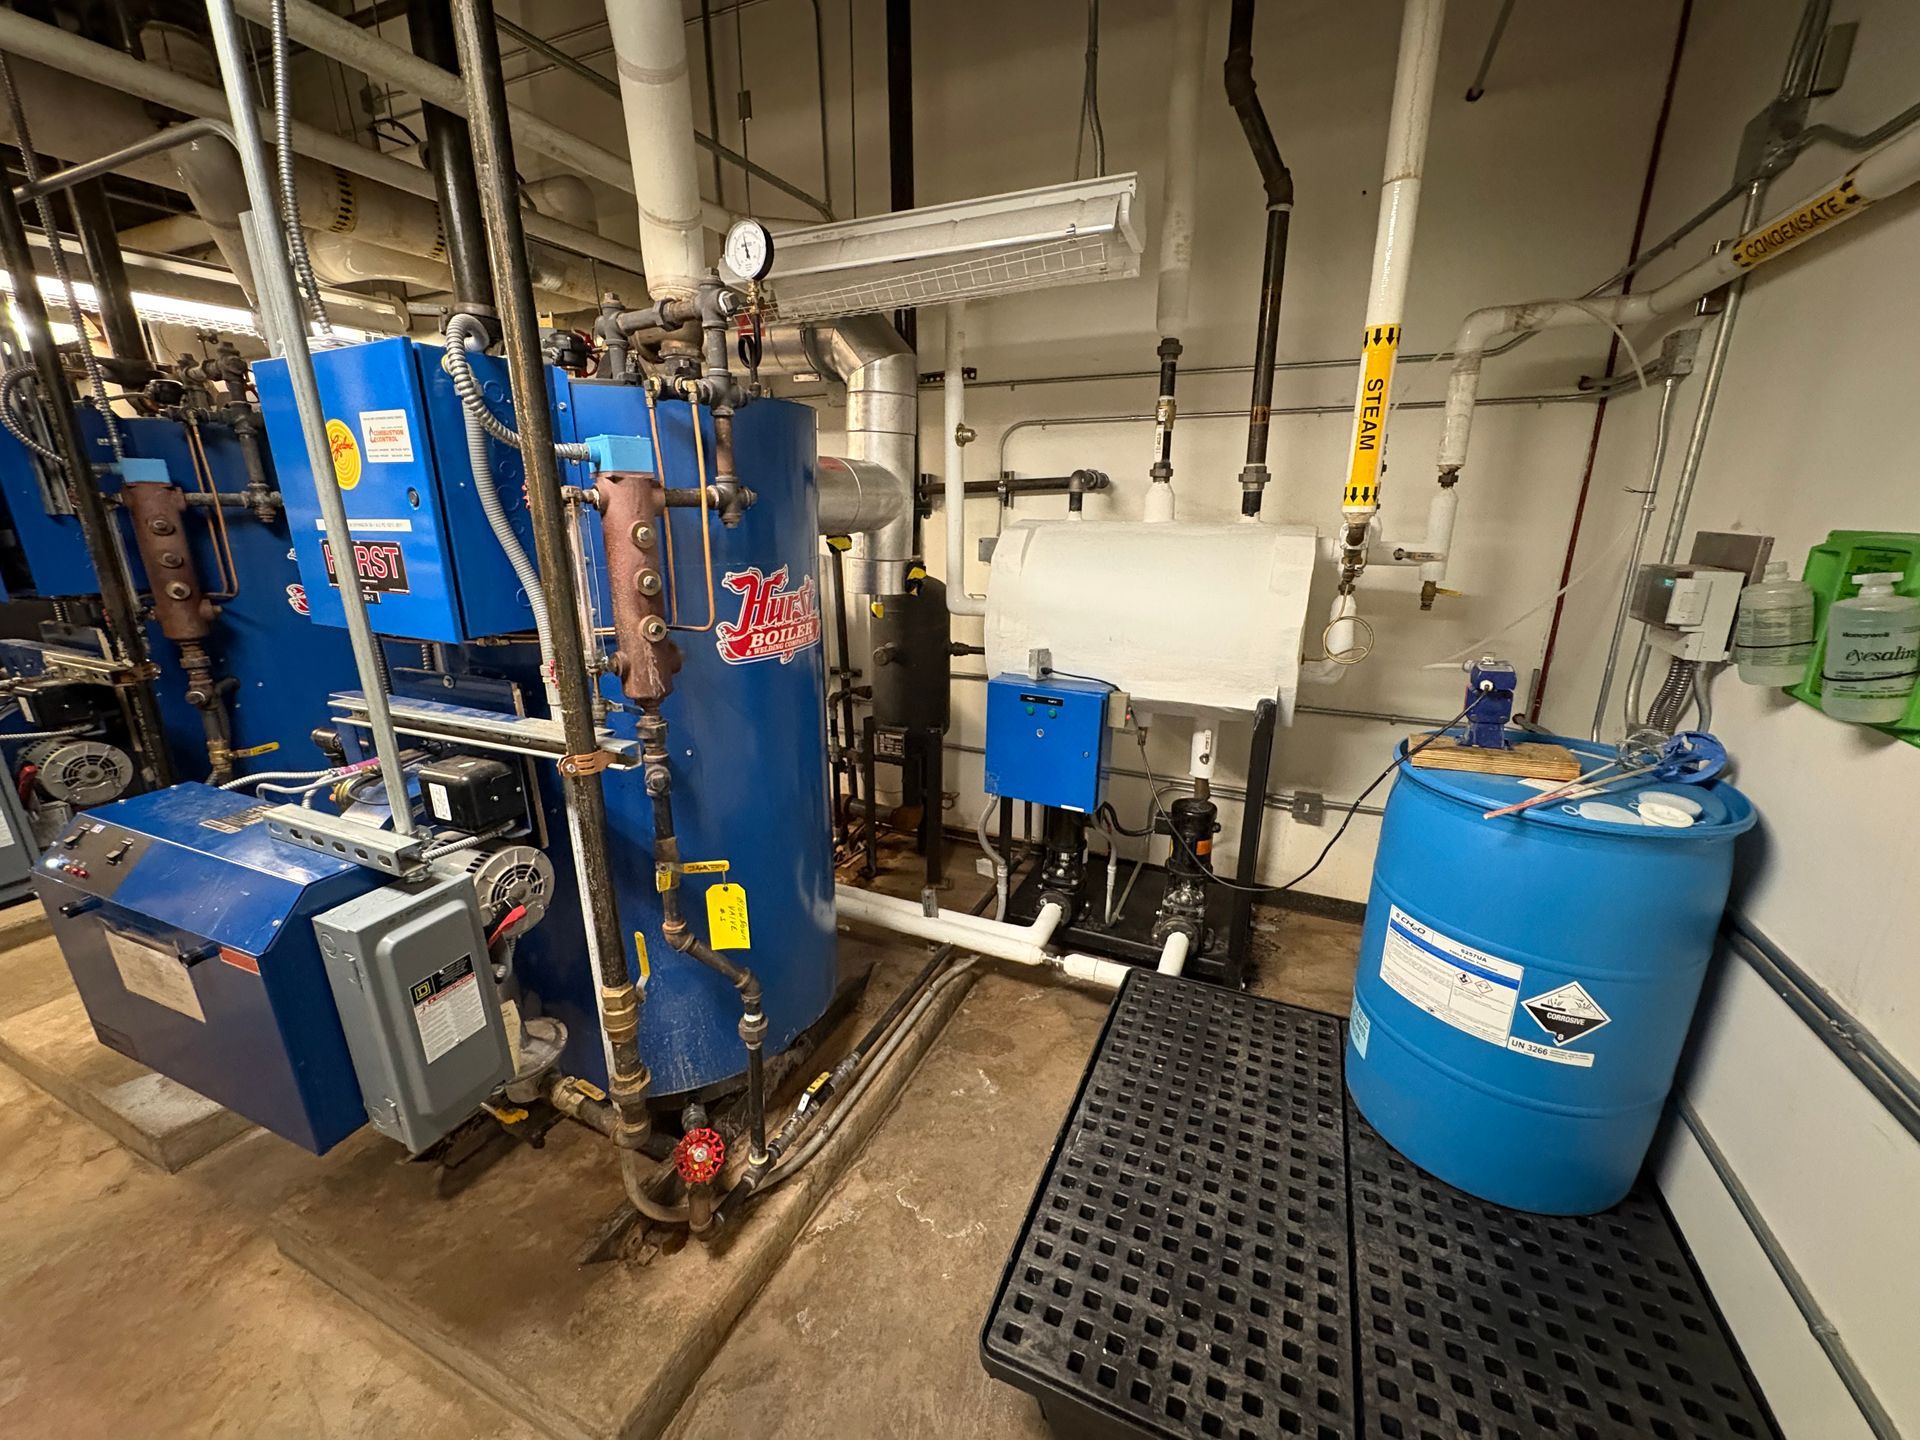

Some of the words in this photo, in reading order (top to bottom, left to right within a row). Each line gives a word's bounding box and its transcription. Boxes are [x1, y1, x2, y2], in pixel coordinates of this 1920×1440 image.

[1745, 196, 1846, 258] CONDENSATE
[1358, 378, 1384, 451] STEAM
[323, 544, 399, 579] HRST
[717, 564, 817, 637] Hurst
[749, 621, 814, 649] BOILER
[1842, 631, 1891, 639] Honeywell
[753, 641, 784, 655] WELDING
[1546, 1012, 1586, 1026] CORROSIVE
[1511, 1039, 1525, 1049] UN
[1527, 1044, 1548, 1056] 3266
[1557, 1033, 1564, 1041] 8
